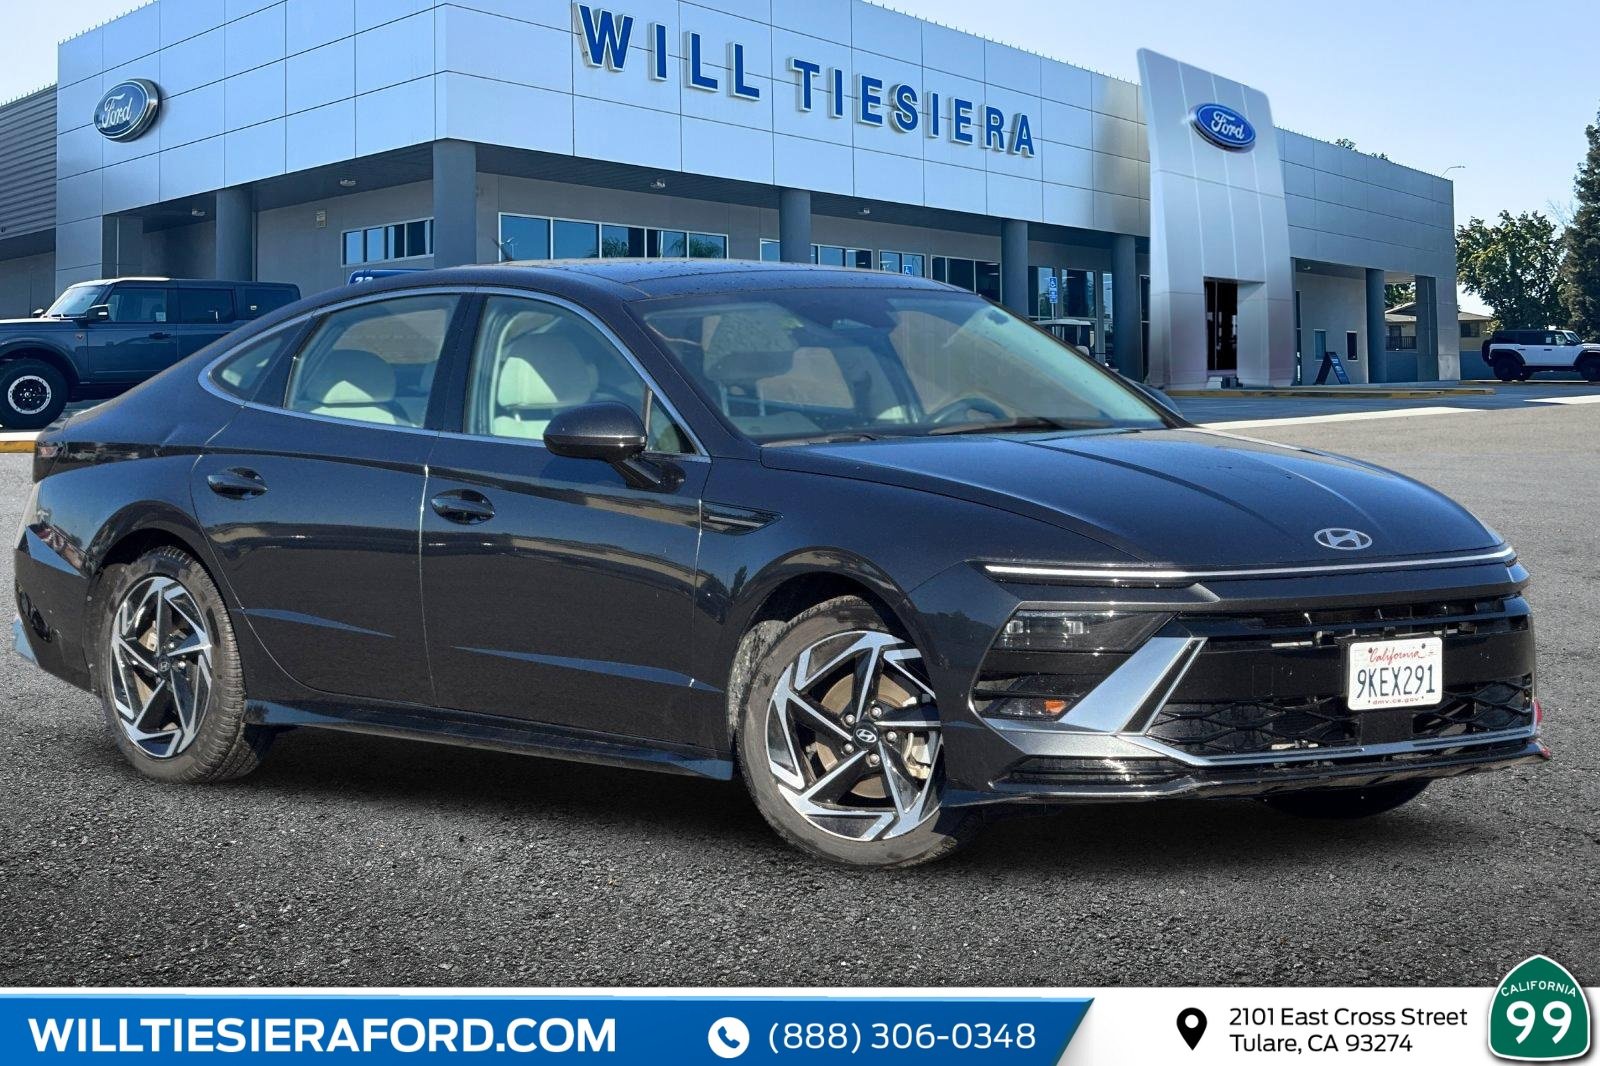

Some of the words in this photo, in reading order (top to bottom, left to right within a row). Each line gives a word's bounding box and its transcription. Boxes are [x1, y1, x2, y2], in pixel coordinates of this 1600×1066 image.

[577, 3, 760, 101] WILL
[791, 58, 1035, 157] TIESIERA
[101, 93, 133, 128] Ford
[1211, 110, 1245, 139] Ford
[1369, 647, 1425, 666] California
[1356, 664, 1436, 699] 9KEX291
